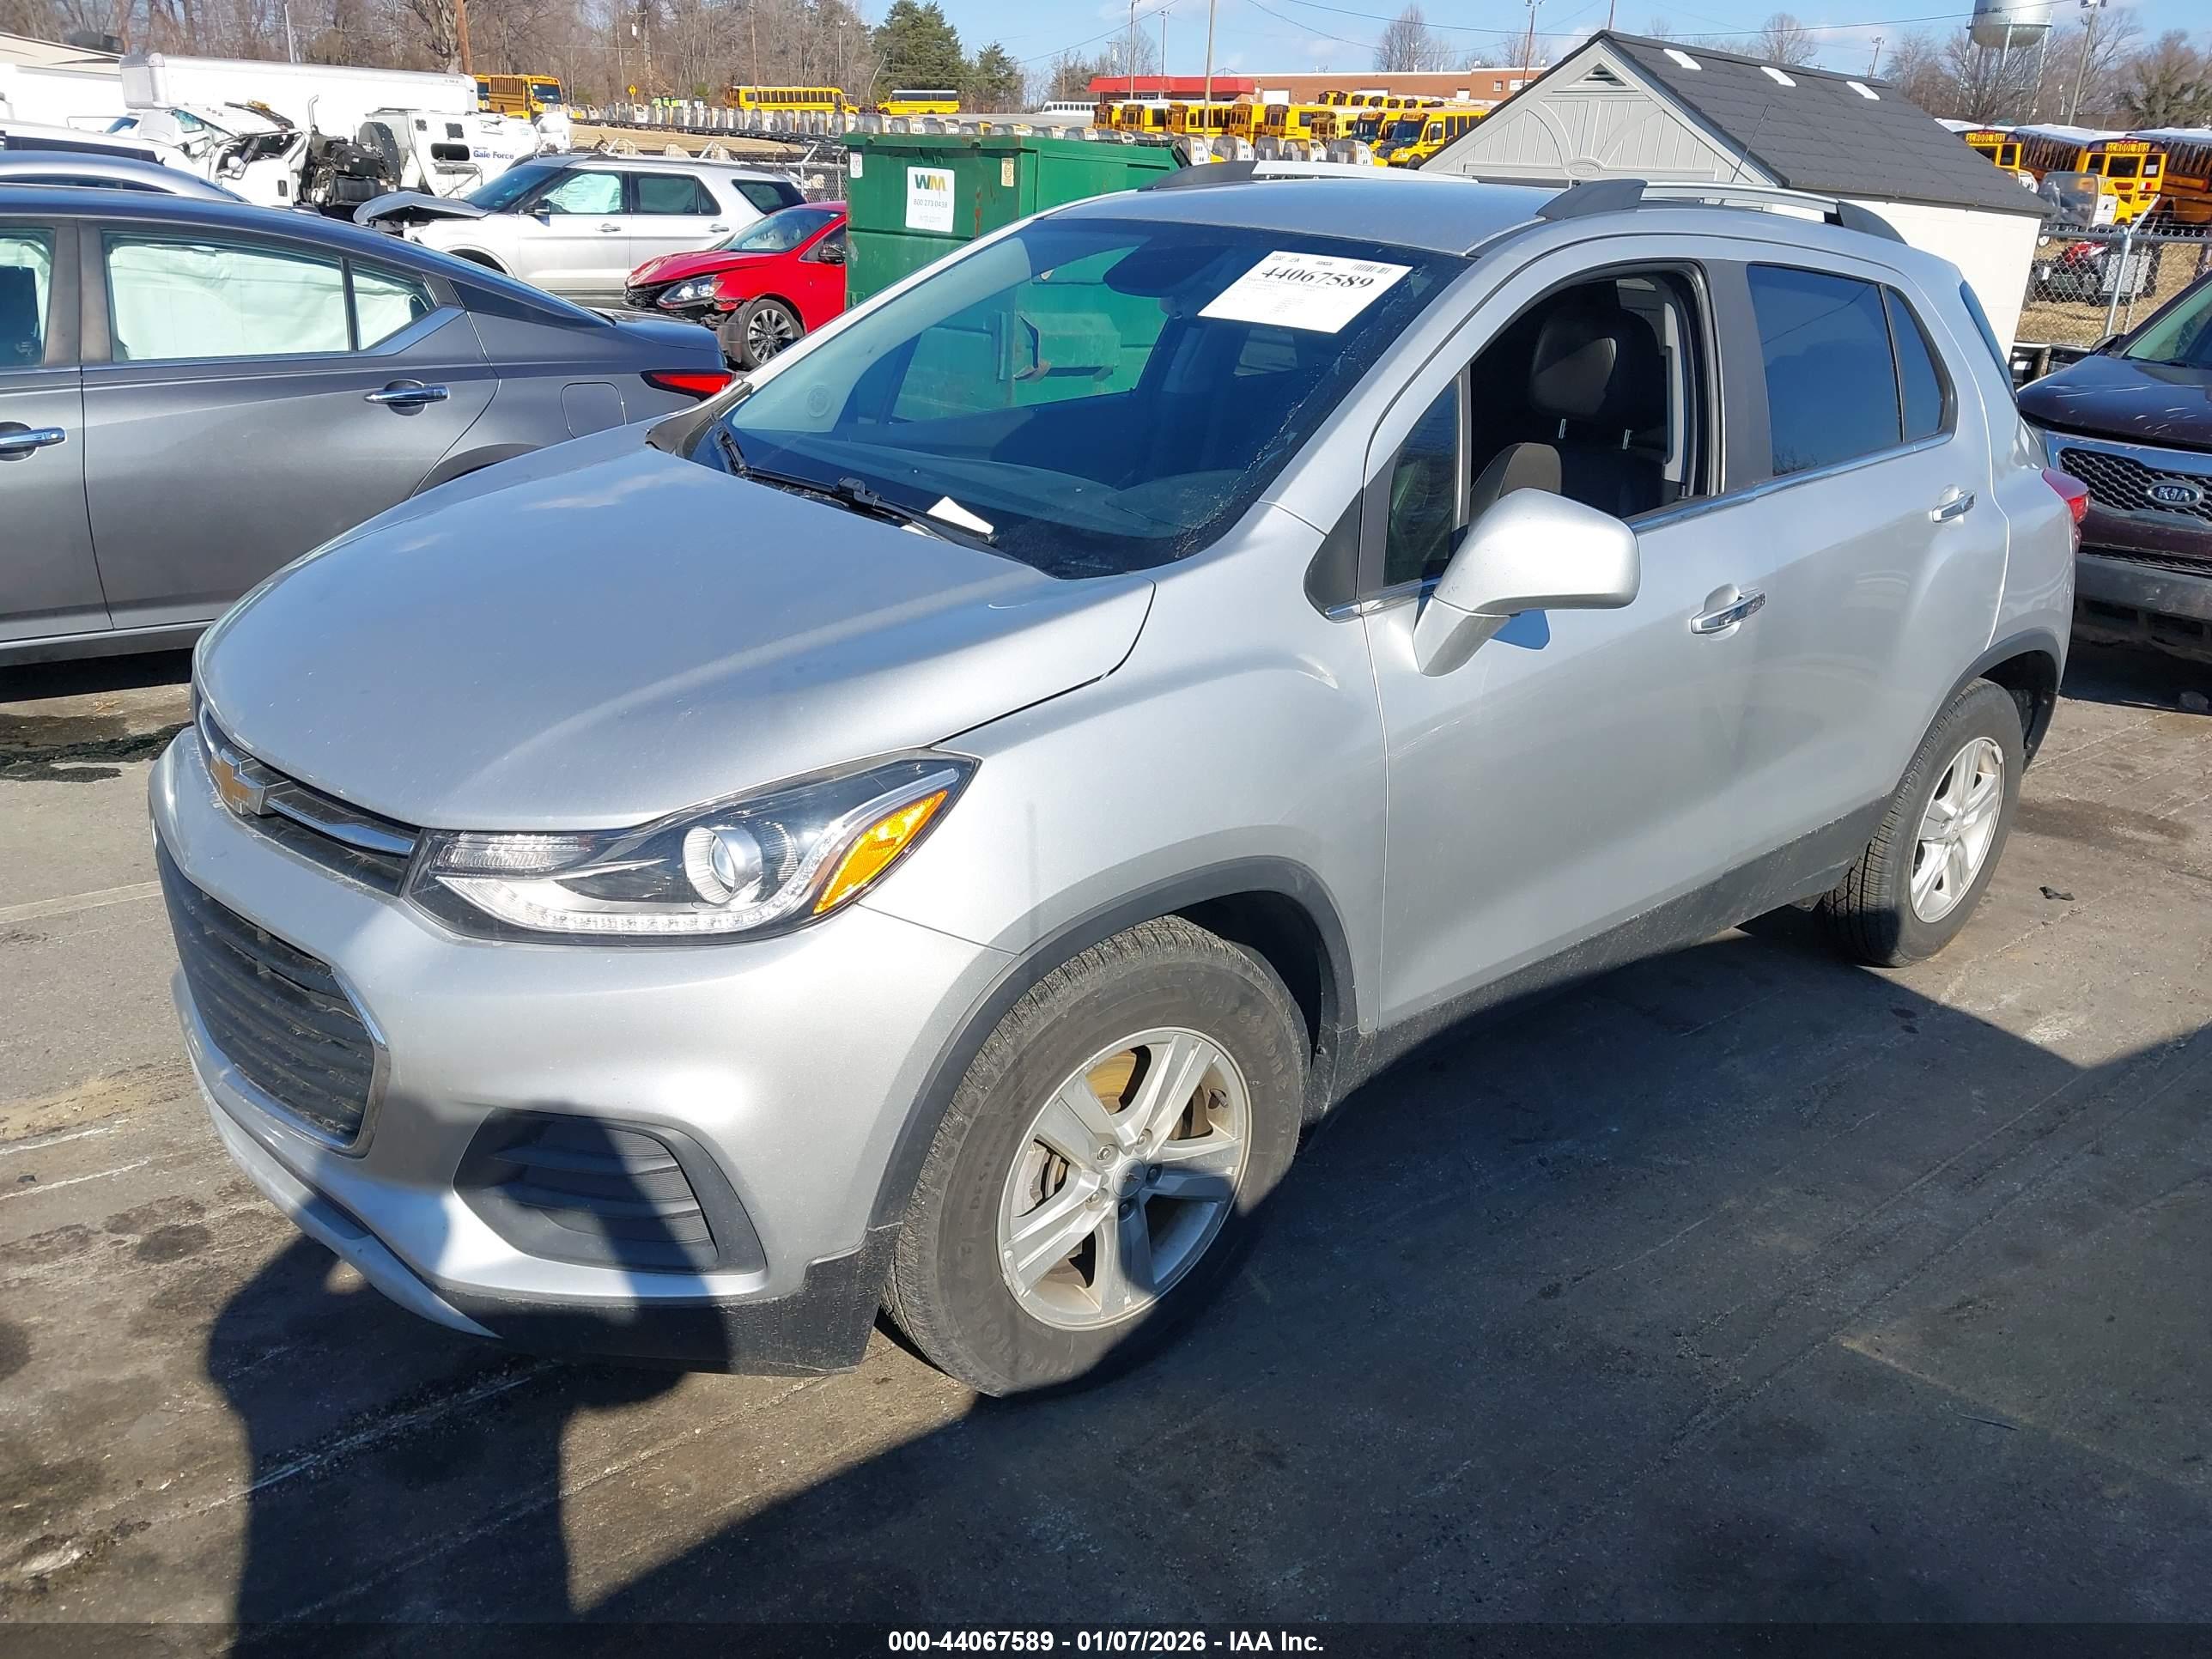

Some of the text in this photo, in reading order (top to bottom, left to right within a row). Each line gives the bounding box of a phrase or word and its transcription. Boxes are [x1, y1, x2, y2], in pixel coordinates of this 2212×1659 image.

[492, 150, 514, 160] Force
[2107, 143, 2149, 152] SCHOOL BUS
[915, 174, 947, 191] WM
[1261, 267, 1375, 289] 44067589
[2157, 486, 2191, 502] KIA
